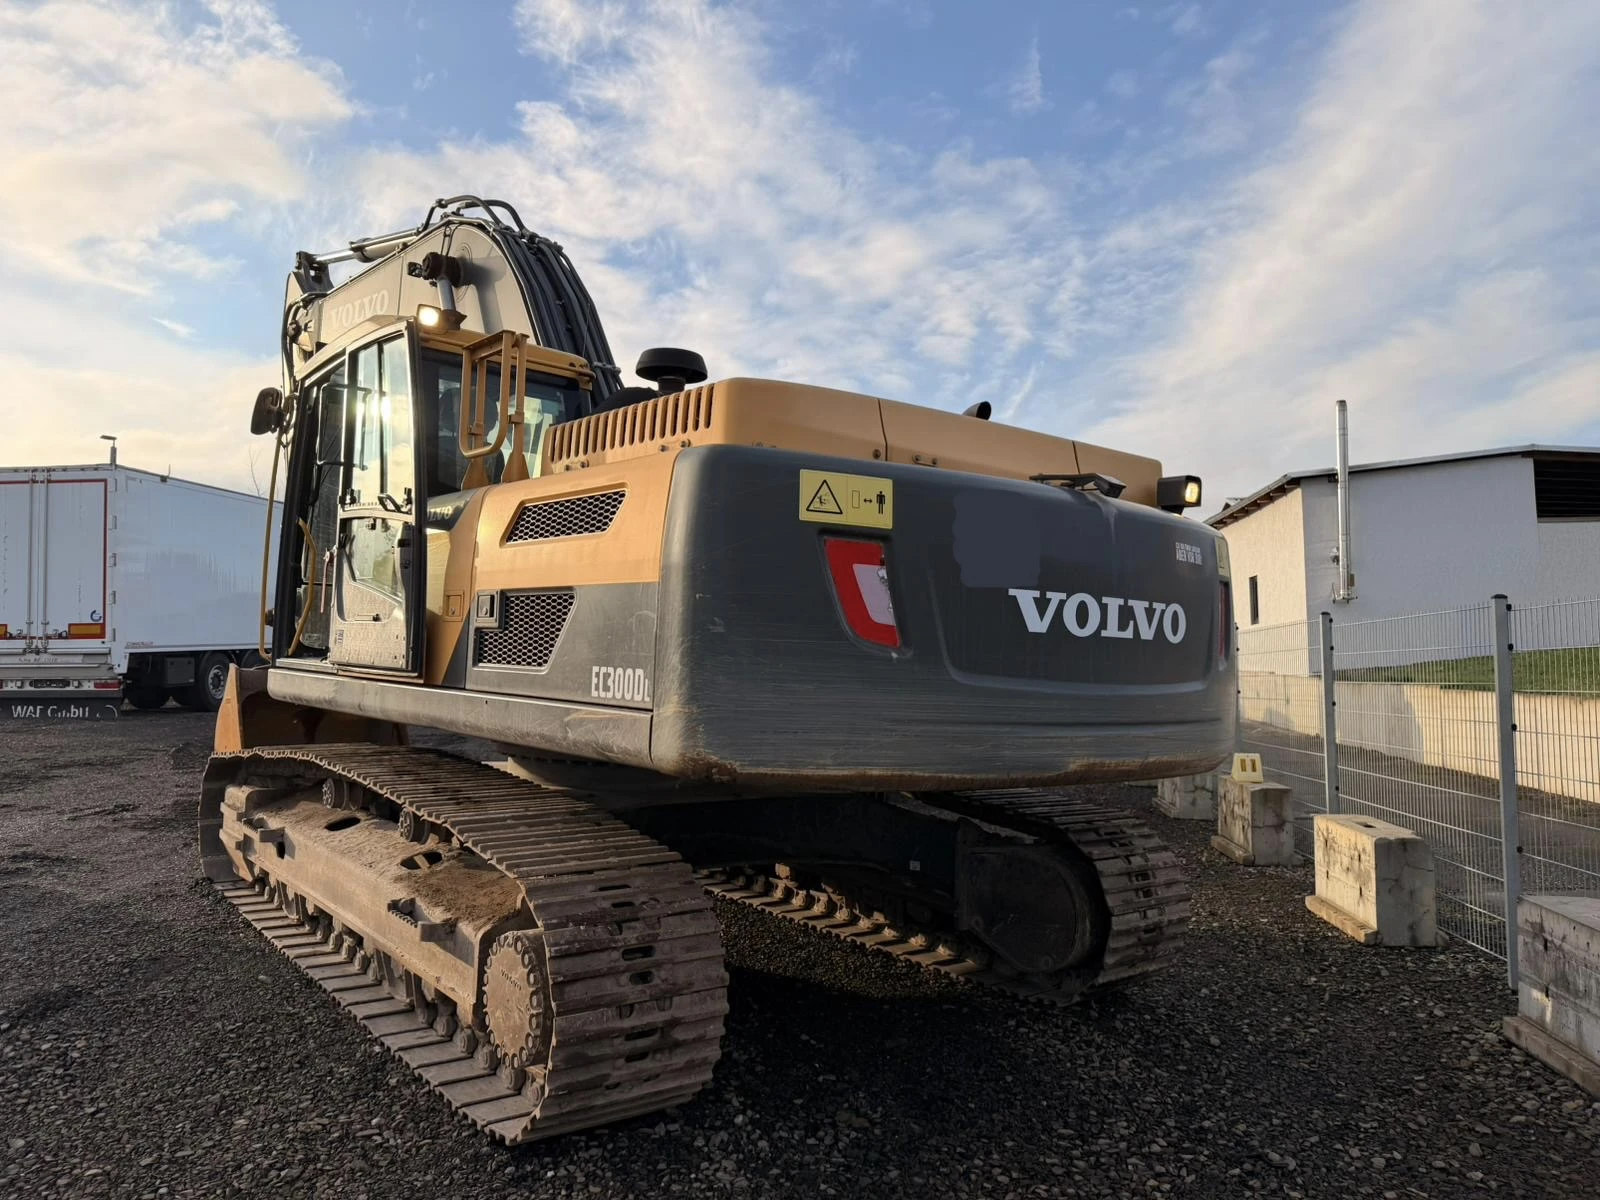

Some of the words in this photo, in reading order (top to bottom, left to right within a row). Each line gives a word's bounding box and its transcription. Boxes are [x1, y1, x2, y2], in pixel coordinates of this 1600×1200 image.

[331, 289, 390, 328] VOLVO
[1008, 588, 1187, 644] VOLVO
[591, 665, 651, 702] EC300DL
